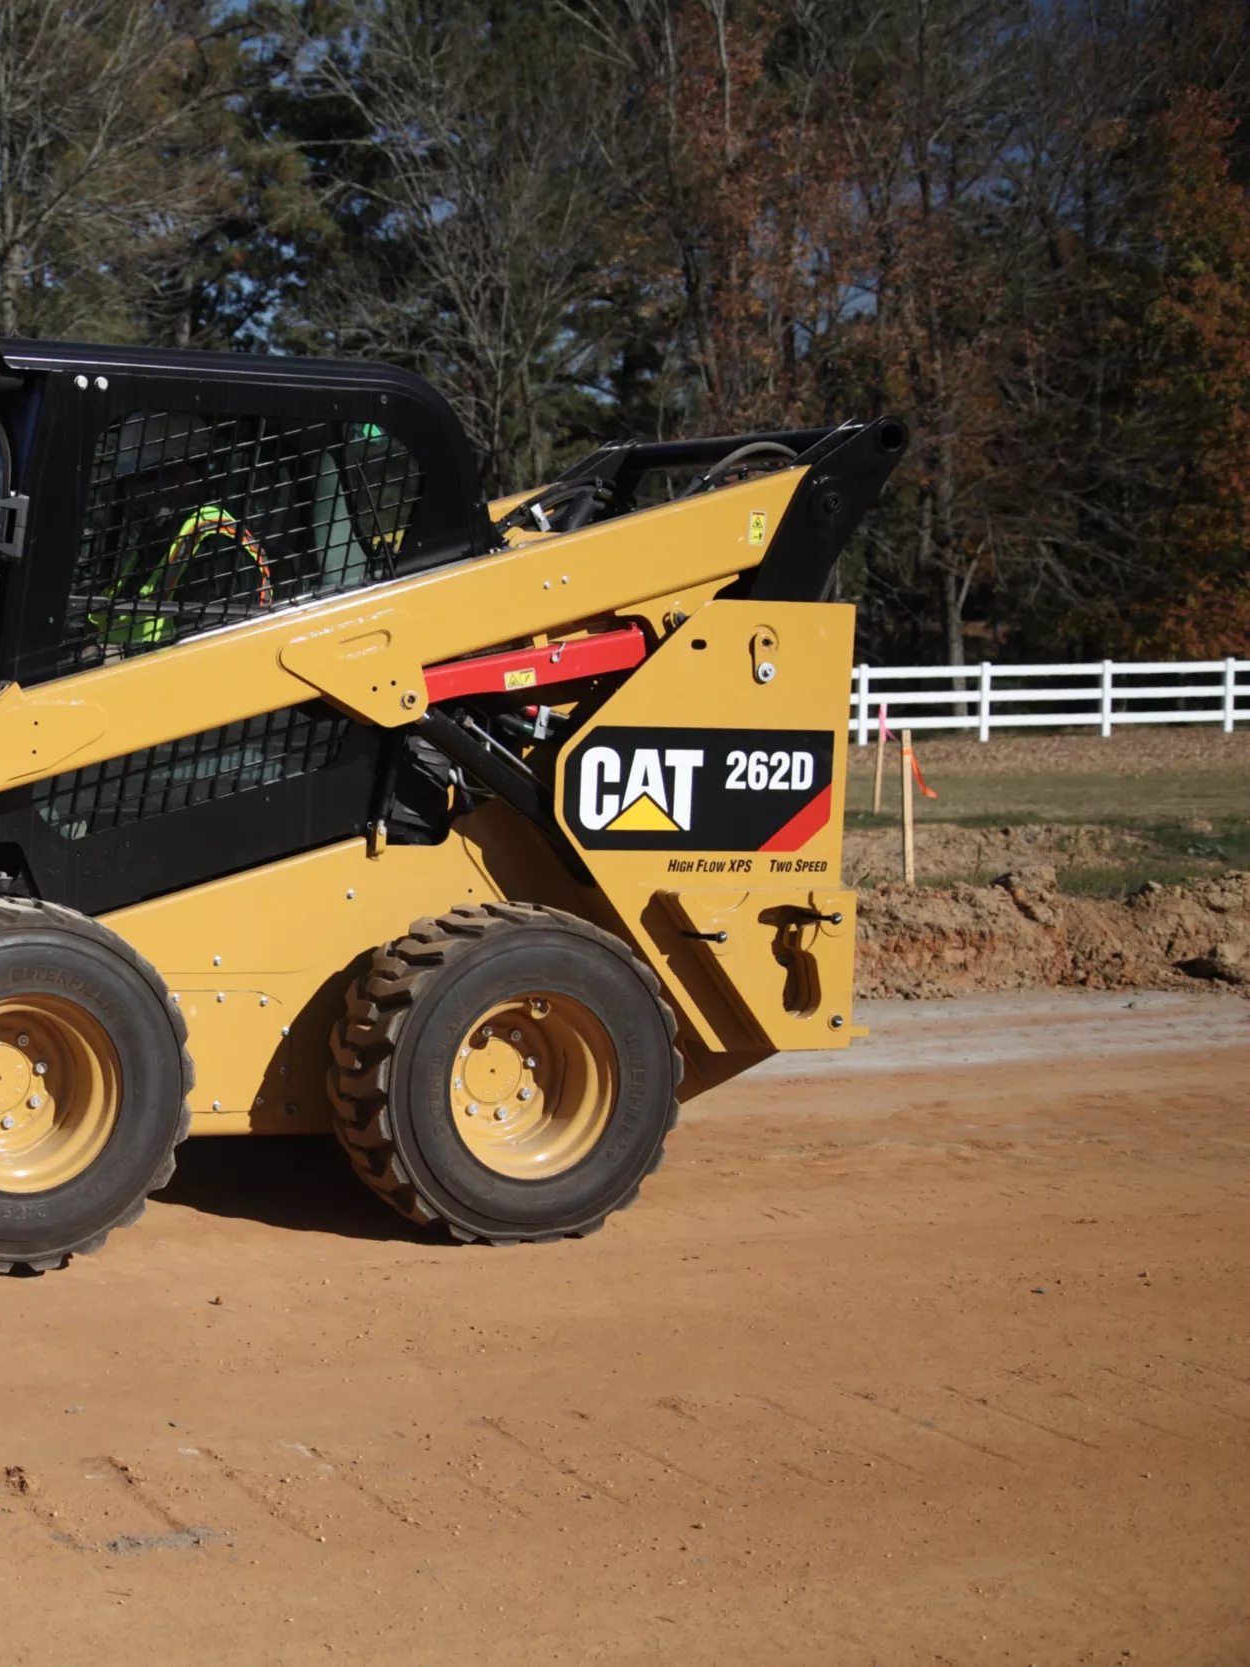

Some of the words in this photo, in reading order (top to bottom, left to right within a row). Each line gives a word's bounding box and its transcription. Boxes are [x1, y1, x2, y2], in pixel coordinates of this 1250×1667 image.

[579, 746, 704, 832] CAT
[724, 750, 814, 791] 262D
[727, 858, 753, 873] XPS
